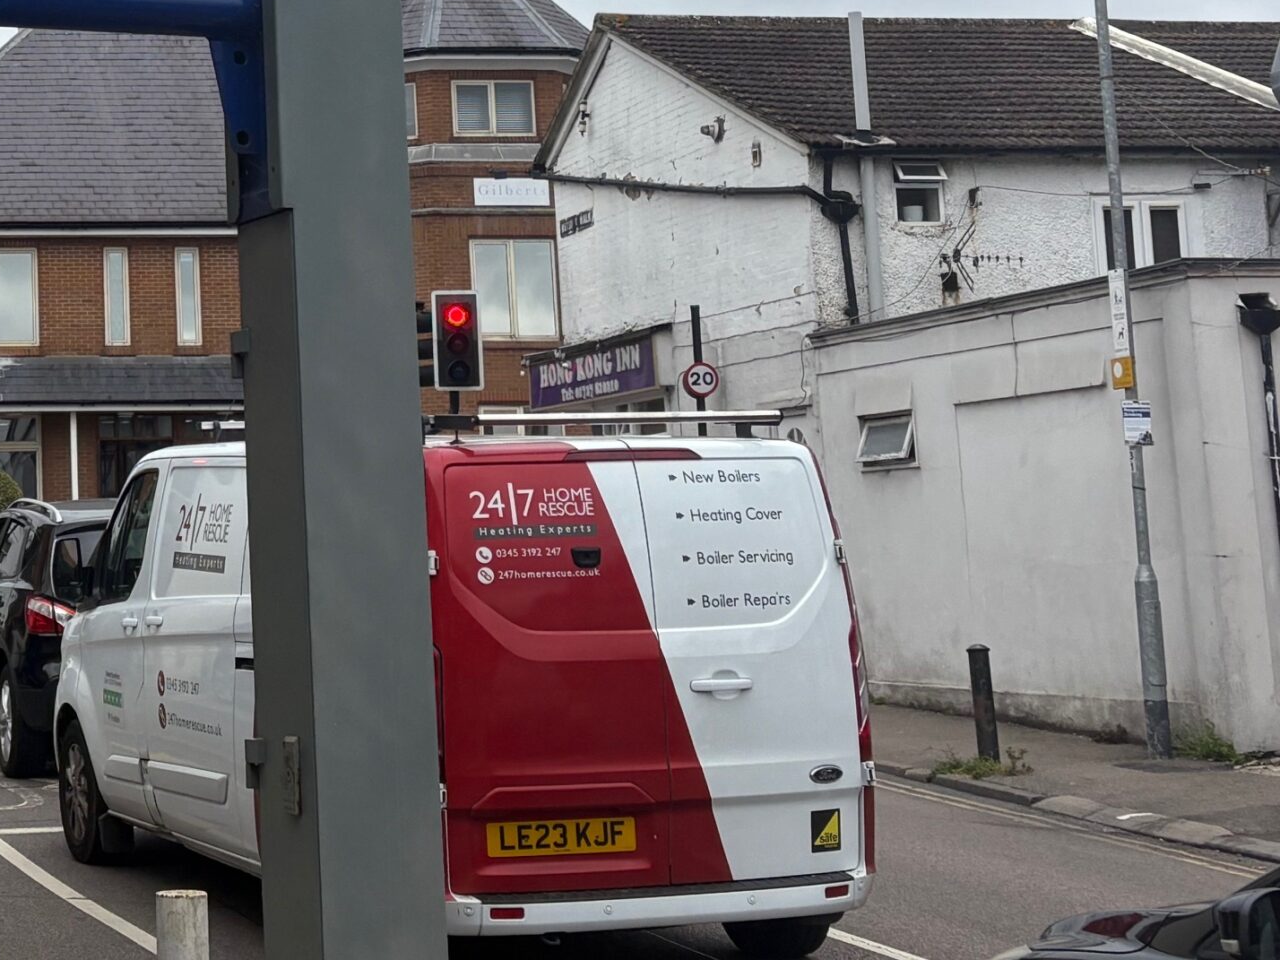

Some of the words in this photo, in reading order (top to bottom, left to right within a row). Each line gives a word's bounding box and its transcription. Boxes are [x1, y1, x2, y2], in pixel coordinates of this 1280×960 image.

[478, 183, 547, 196] Gilberts
[539, 360, 573, 389] HONG
[575, 351, 613, 382] KONG
[615, 343, 641, 373] INN
[690, 371, 714, 386] 20
[682, 470, 714, 484] New
[717, 469, 761, 483] Boilers
[542, 487, 594, 503] HOME
[209, 503, 234, 523] HOME
[538, 501, 595, 517] RESCUE
[690, 507, 743, 524] Heating
[745, 507, 783, 520] Cover
[203, 522, 230, 544] RESCUE
[479, 526, 533, 537] Heating
[539, 524, 592, 535] Experts
[496, 548, 519, 558] 0345
[521, 547, 542, 558] 3192
[545, 547, 562, 557] 247
[696, 550, 735, 565] Boiler
[738, 549, 794, 566] Servicing
[199, 555, 224, 571] Experts
[498, 568, 601, 580] 247homerescue.co.uk
[701, 594, 739, 609] Boiler
[499, 823, 568, 851] LE23
[575, 821, 625, 848] KJF
[820, 833, 838, 844] safe
